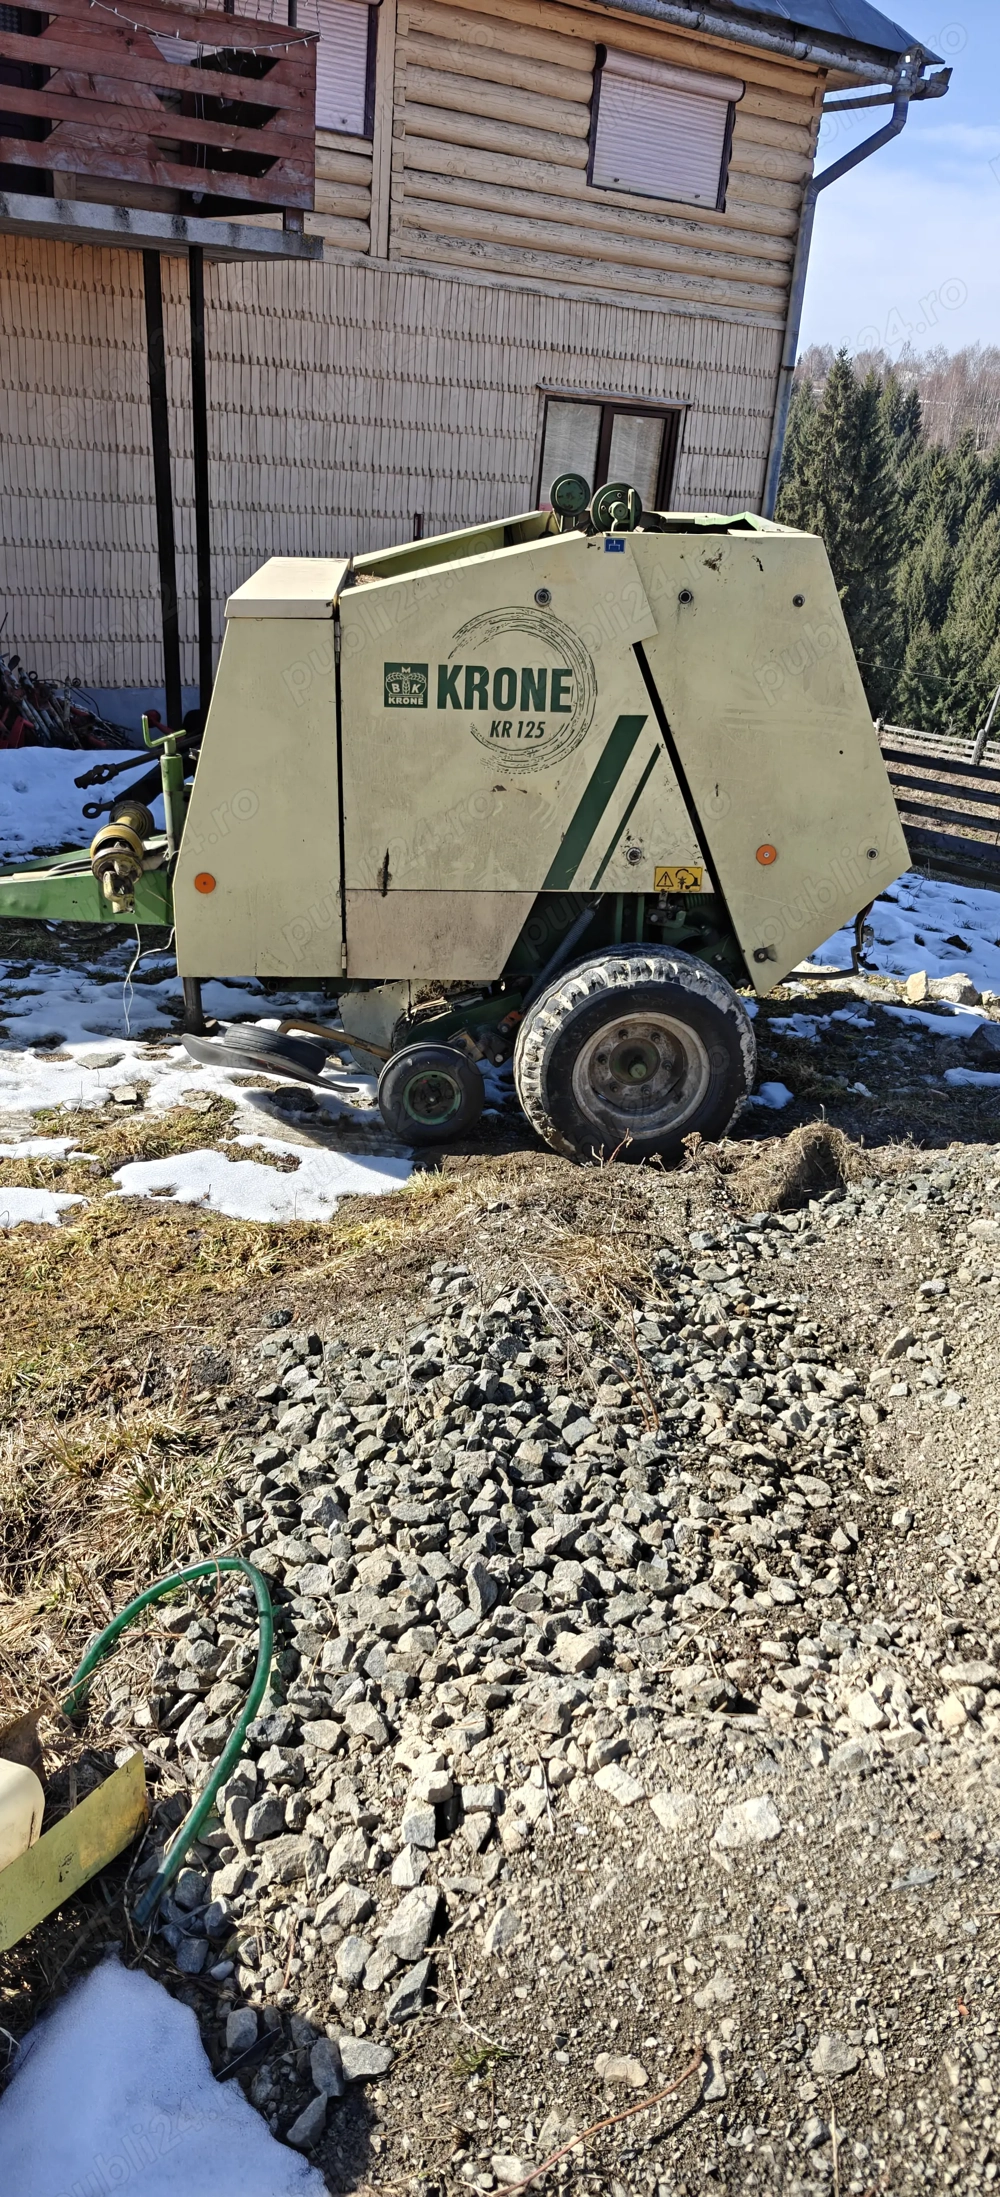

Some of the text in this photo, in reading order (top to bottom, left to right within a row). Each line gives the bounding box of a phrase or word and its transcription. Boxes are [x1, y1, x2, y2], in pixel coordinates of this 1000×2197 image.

[391, 683, 421, 693] B K
[437, 664, 573, 713] KRONE
[388, 697, 424, 705] KRONE
[489, 720, 546, 739] KR 125
